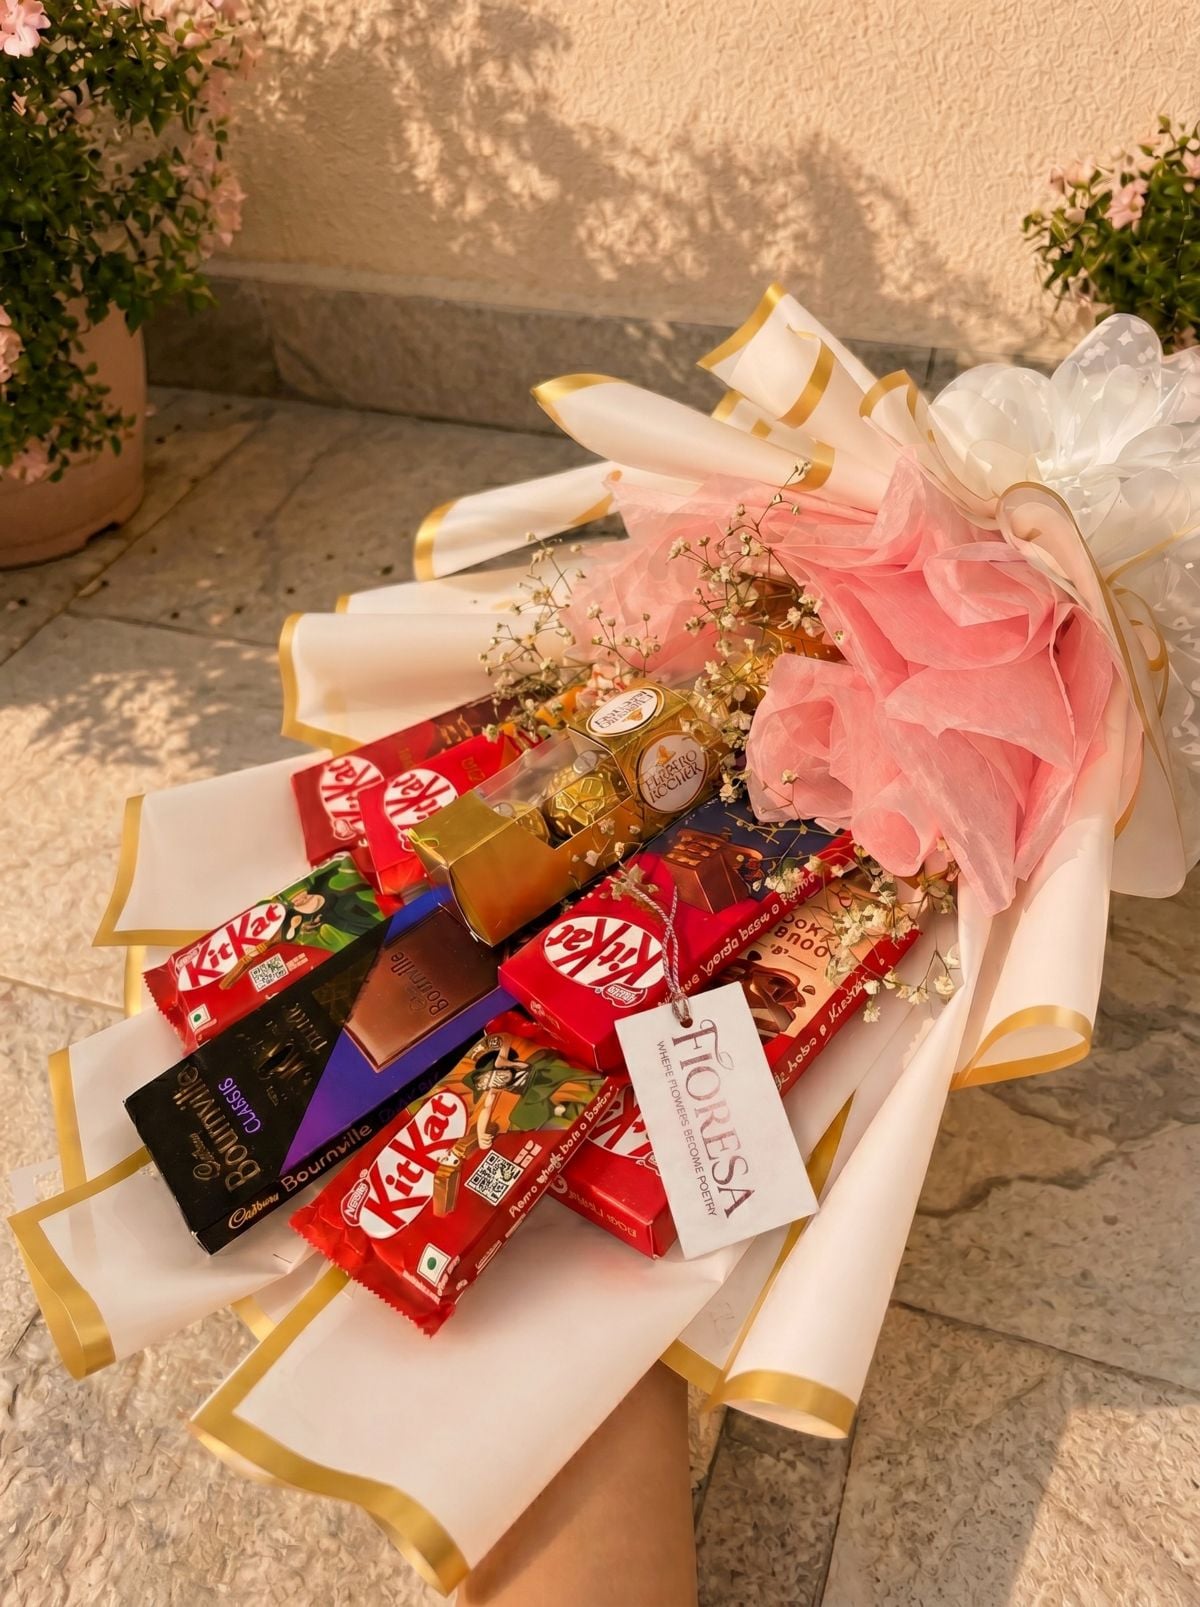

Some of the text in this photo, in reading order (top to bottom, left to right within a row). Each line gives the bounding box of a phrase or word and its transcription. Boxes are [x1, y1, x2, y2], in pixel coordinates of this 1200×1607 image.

[184, 903, 284, 990] KitKat
[546, 917, 664, 989] KitKat
[172, 1063, 263, 1194] Bournville
[280, 1122, 374, 1193] Bournville
[364, 1094, 459, 1230] KitKat
[682, 1128, 703, 1173] BECOME
